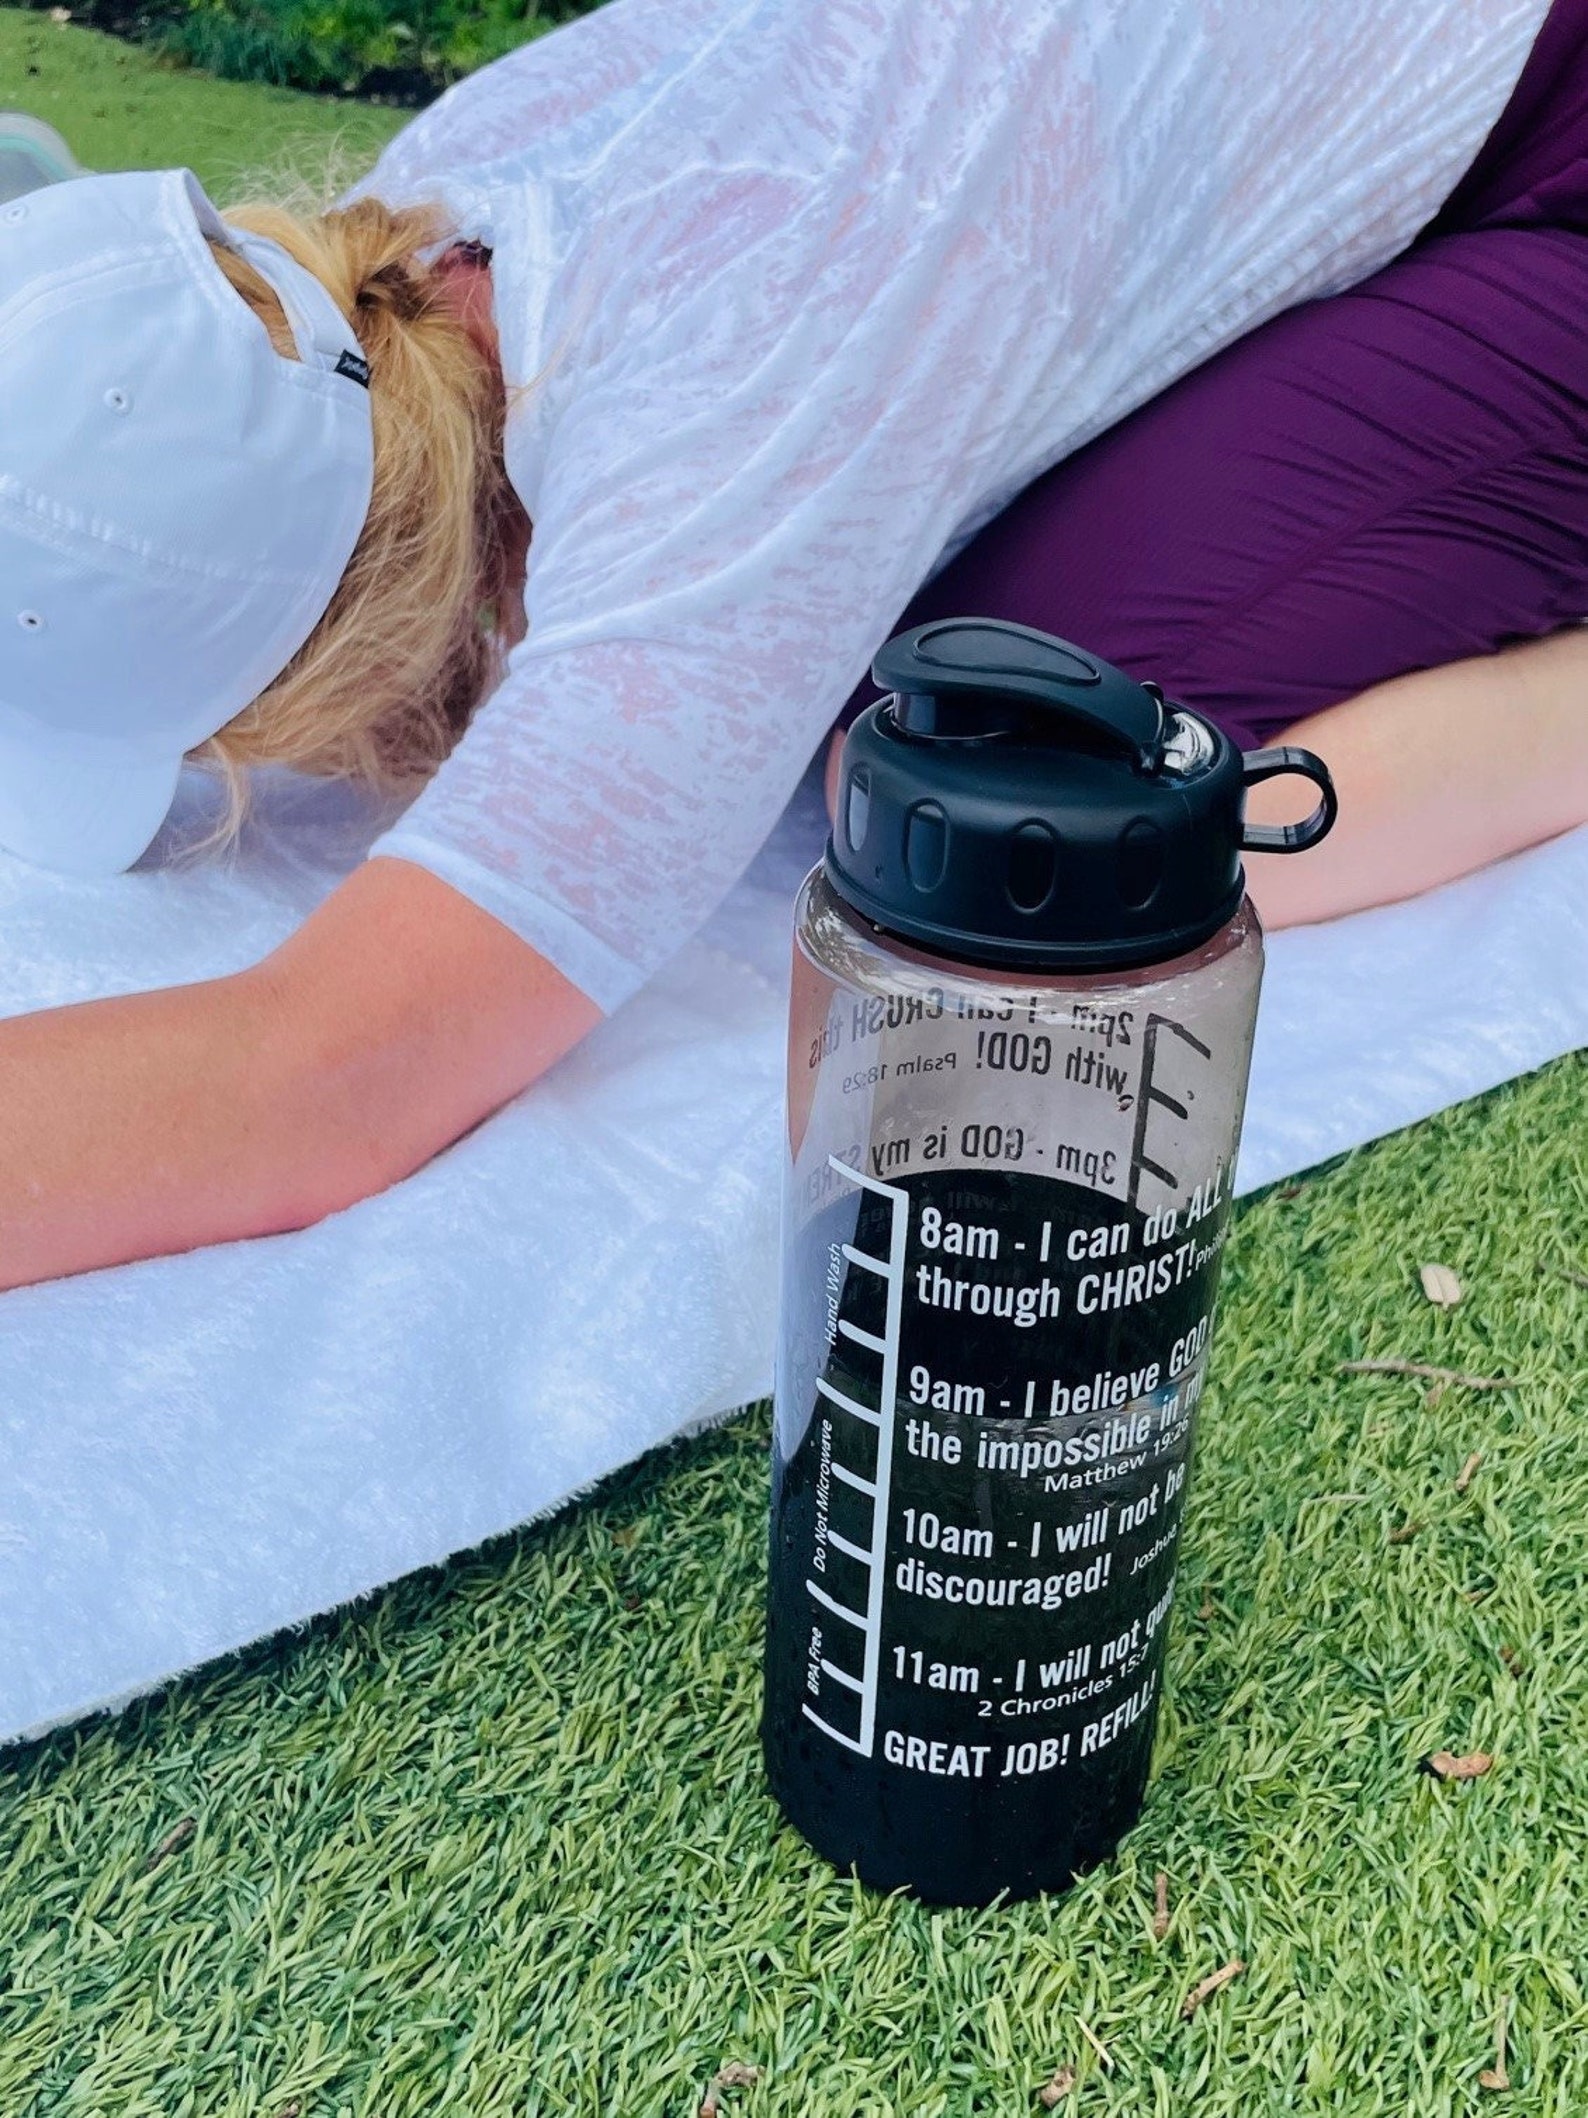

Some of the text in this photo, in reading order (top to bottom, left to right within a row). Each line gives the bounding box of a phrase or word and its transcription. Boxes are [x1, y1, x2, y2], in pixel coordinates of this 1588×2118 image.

[920, 1206, 999, 1261] 8am
[1014, 1242, 1026, 1250] -
[1039, 1221, 1052, 1262] I
[1066, 1222, 1131, 1262] can
[1143, 1204, 1178, 1247] do
[1185, 1168, 1222, 1229] ALL
[824, 1242, 841, 1346] Hand Wash
[916, 1264, 1061, 1328] through
[1076, 1238, 1197, 1316] CHRIST!
[909, 1365, 986, 1417] 9am
[1024, 1381, 1036, 1419] I
[1049, 1362, 1160, 1418] believe
[905, 1418, 963, 1465] the
[977, 1411, 1151, 1479] impossible
[1159, 1394, 1179, 1432] in
[1044, 1451, 1148, 1493] Matthew
[812, 1419, 833, 1573] Do Not Microwave
[903, 1508, 994, 1558] 10am
[1030, 1521, 1041, 1558] I
[1056, 1507, 1110, 1554] will
[1117, 1482, 1160, 1536] not
[1164, 1462, 1186, 1505] be
[896, 1552, 1113, 1611] discouraged!
[807, 1626, 823, 1696] BPA Free
[893, 1644, 980, 1693] 11am
[1015, 1659, 1027, 1692] I
[1039, 1643, 1092, 1691] will
[1100, 1618, 1141, 1670] not
[978, 1643, 1150, 1717] 2 Chronicles 15:7
[883, 1668, 1159, 1778] GREAT JOB! REFILL!
